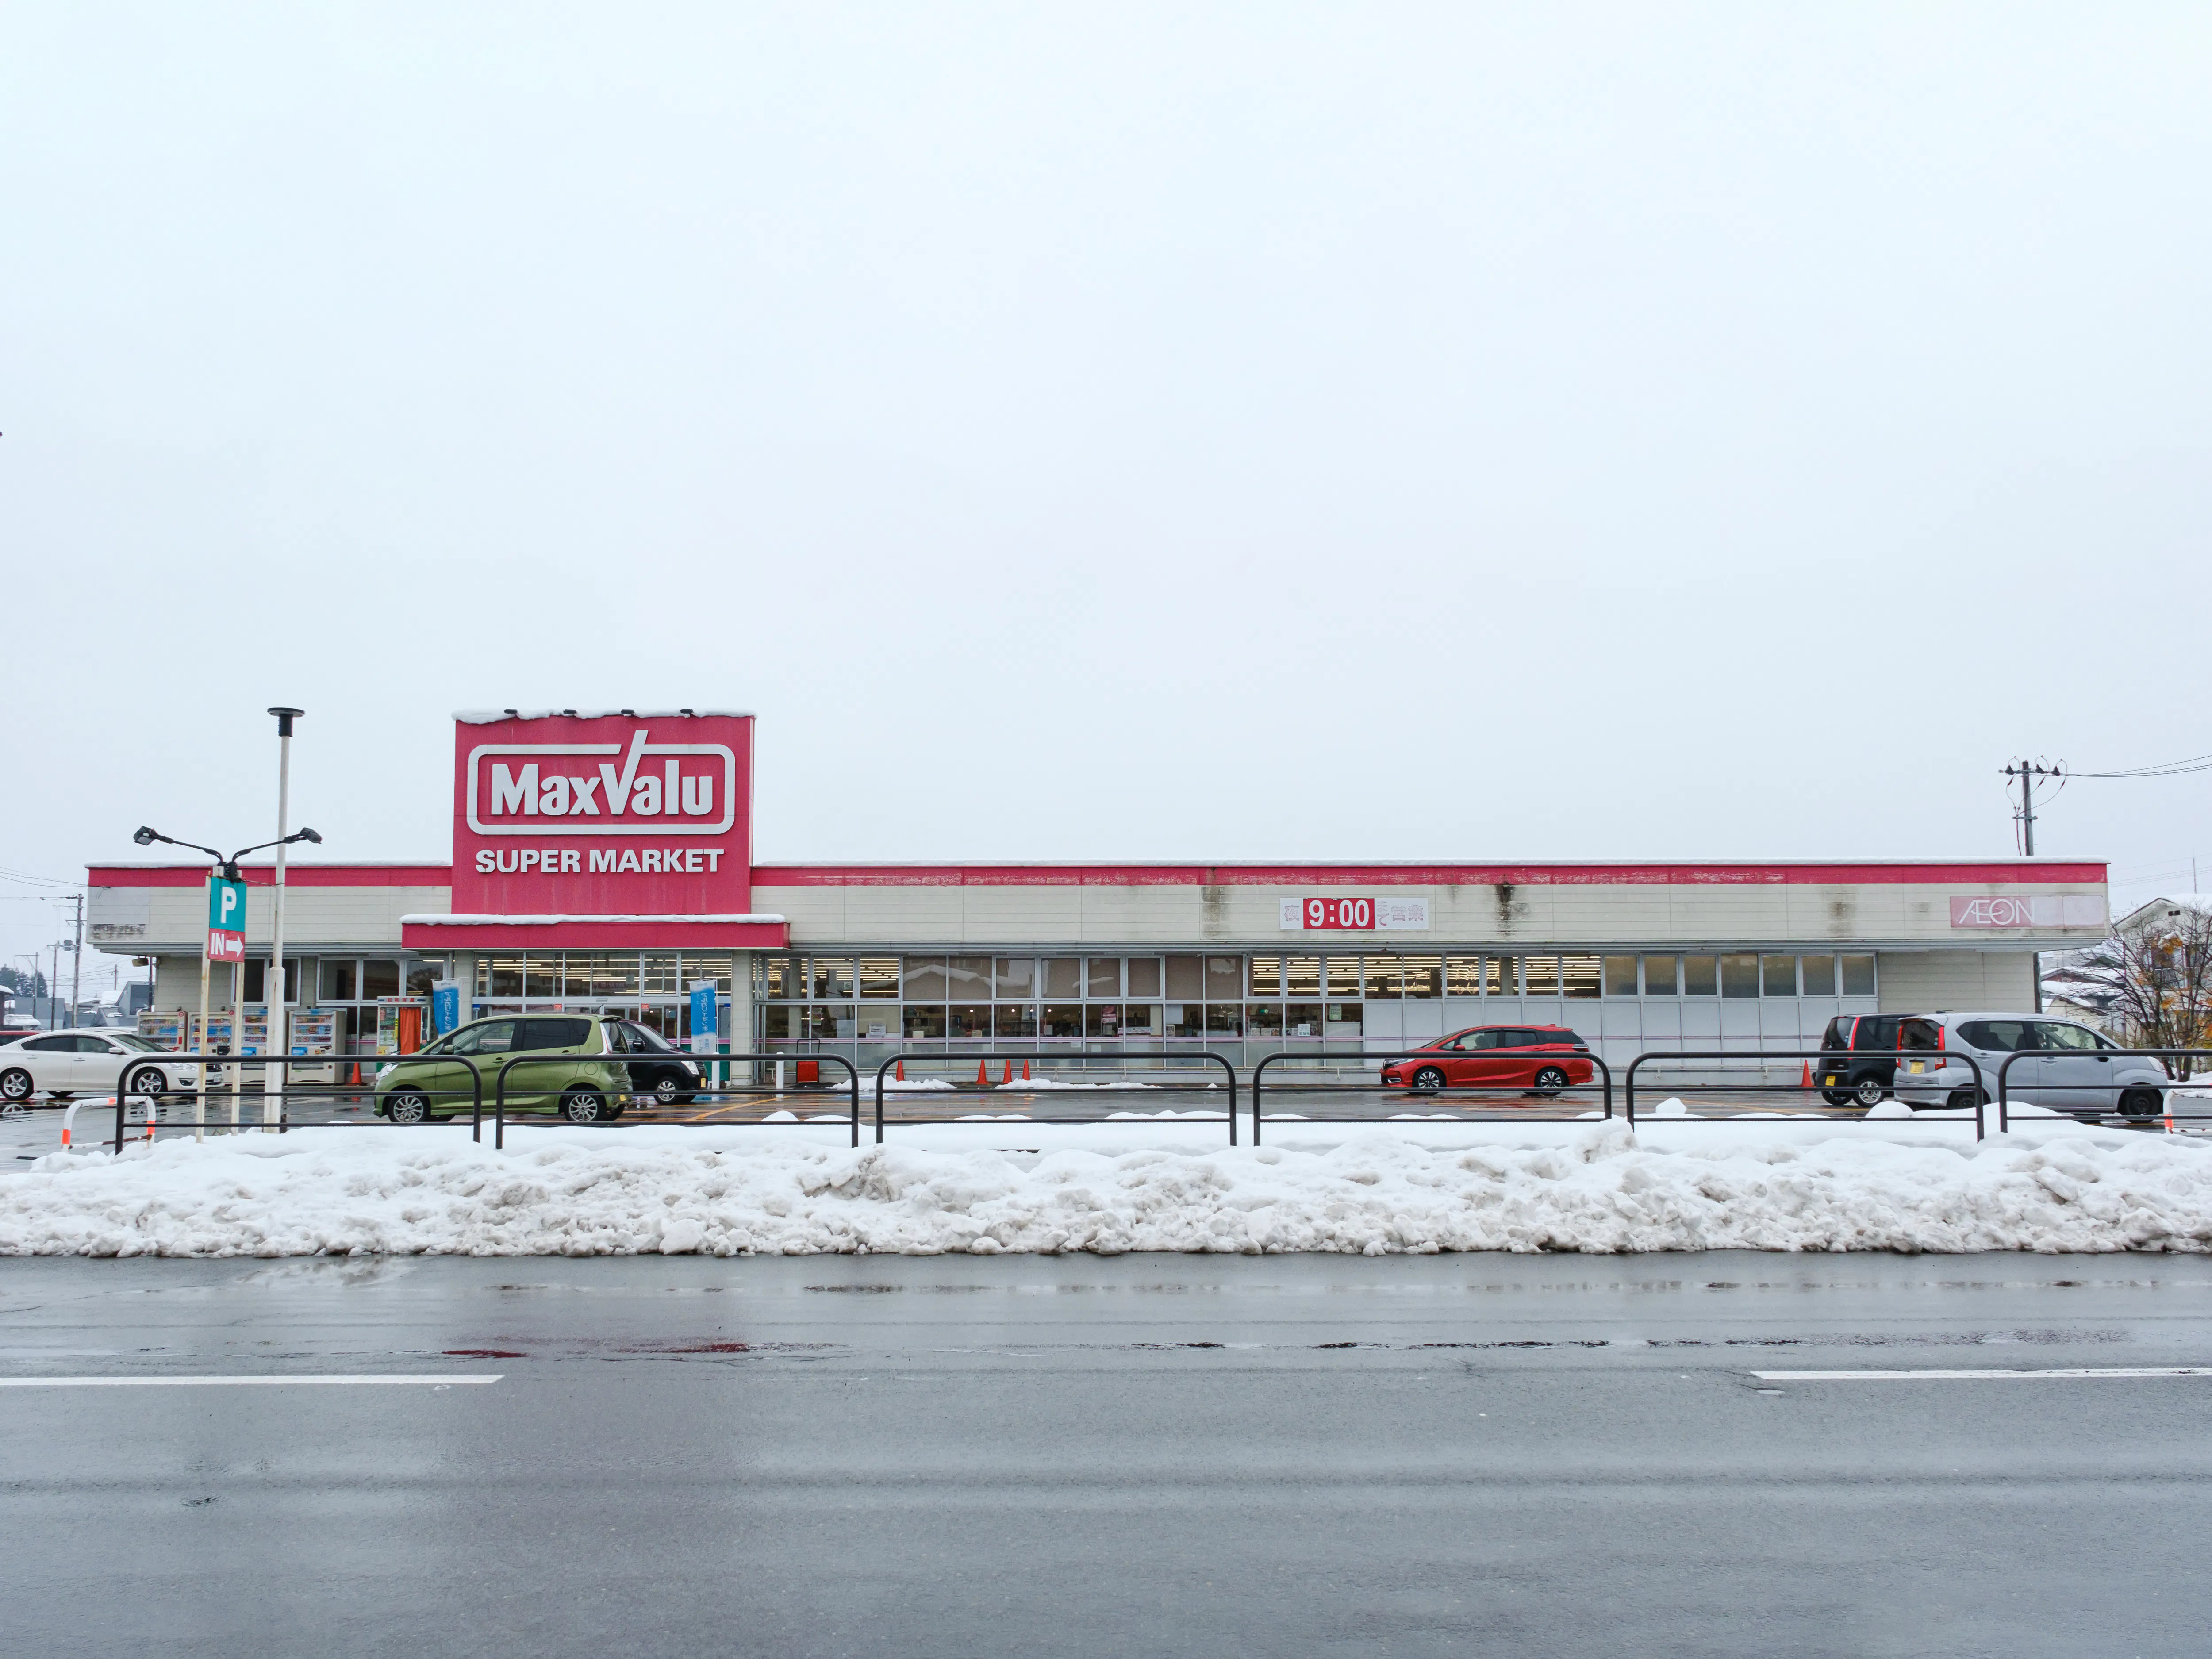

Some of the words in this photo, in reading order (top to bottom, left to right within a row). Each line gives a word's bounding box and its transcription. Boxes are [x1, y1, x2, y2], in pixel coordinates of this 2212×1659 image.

[491, 730, 713, 815] MaxValu
[476, 849, 581, 873] SUPER
[589, 849, 724, 872] MARKET
[221, 886, 237, 923] P
[211, 932, 225, 956] IN
